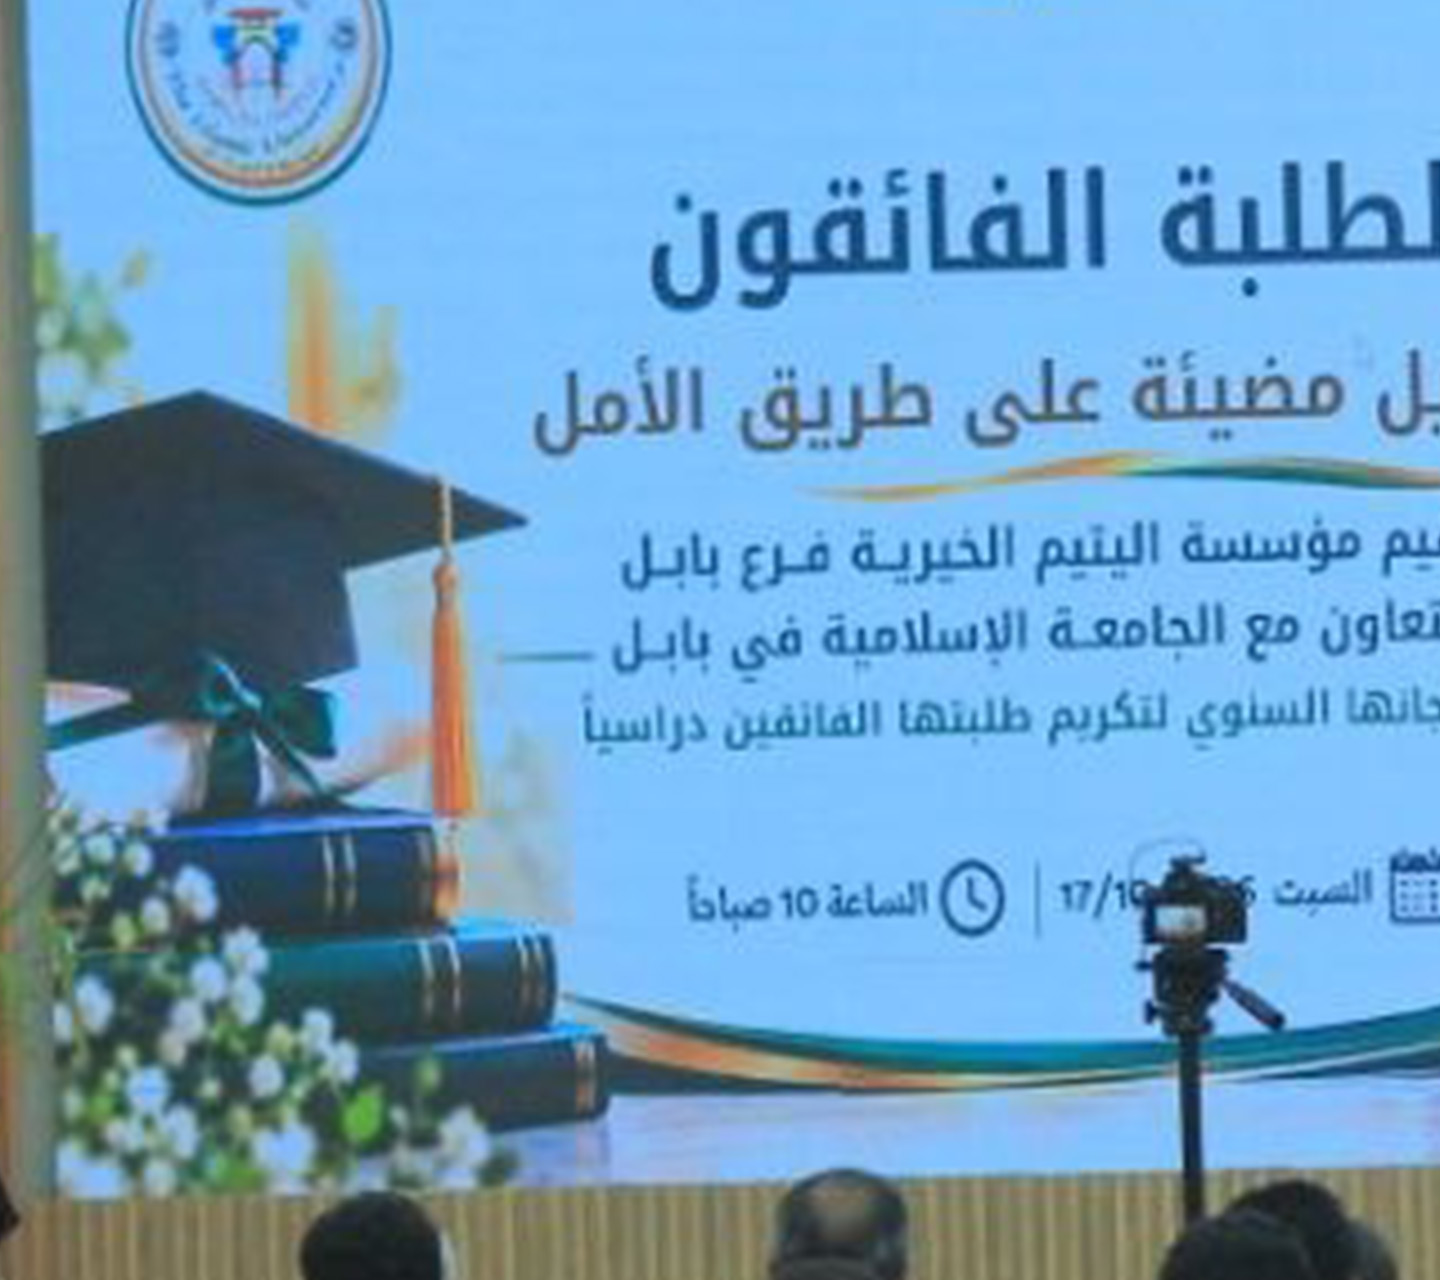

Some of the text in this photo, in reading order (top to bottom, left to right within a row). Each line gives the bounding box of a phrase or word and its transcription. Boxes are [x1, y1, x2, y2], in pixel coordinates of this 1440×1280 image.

[650, 165, 1108, 314] الفائقون
[534, 354, 705, 458] الأمل
[739, 361, 934, 454] طريق
[965, 357, 1102, 448] على
[1132, 350, 1346, 442] مضيئة
[620, 531, 721, 594] بابل
[739, 535, 832, 594] فرع
[850, 523, 1015, 586] الخيرية
[1035, 520, 1160, 587] اليتيم
[1180, 518, 1363, 577] مؤسسة
[611, 616, 712, 677] بابل
[730, 615, 803, 686] في
[821, 607, 1028, 670] الإسلامية
[1047, 602, 1227, 662] الجامعة
[1244, 612, 1301, 664] مع
[722, 697, 882, 752] الفائقين
[897, 694, 1032, 748] طلبتها
[1047, 688, 1168, 747] لتكريم
[1185, 687, 1330, 752] السنوي
[778, 884, 821, 920] 10
[824, 879, 930, 919] الساعة
[1272, 867, 1374, 917] السبت
